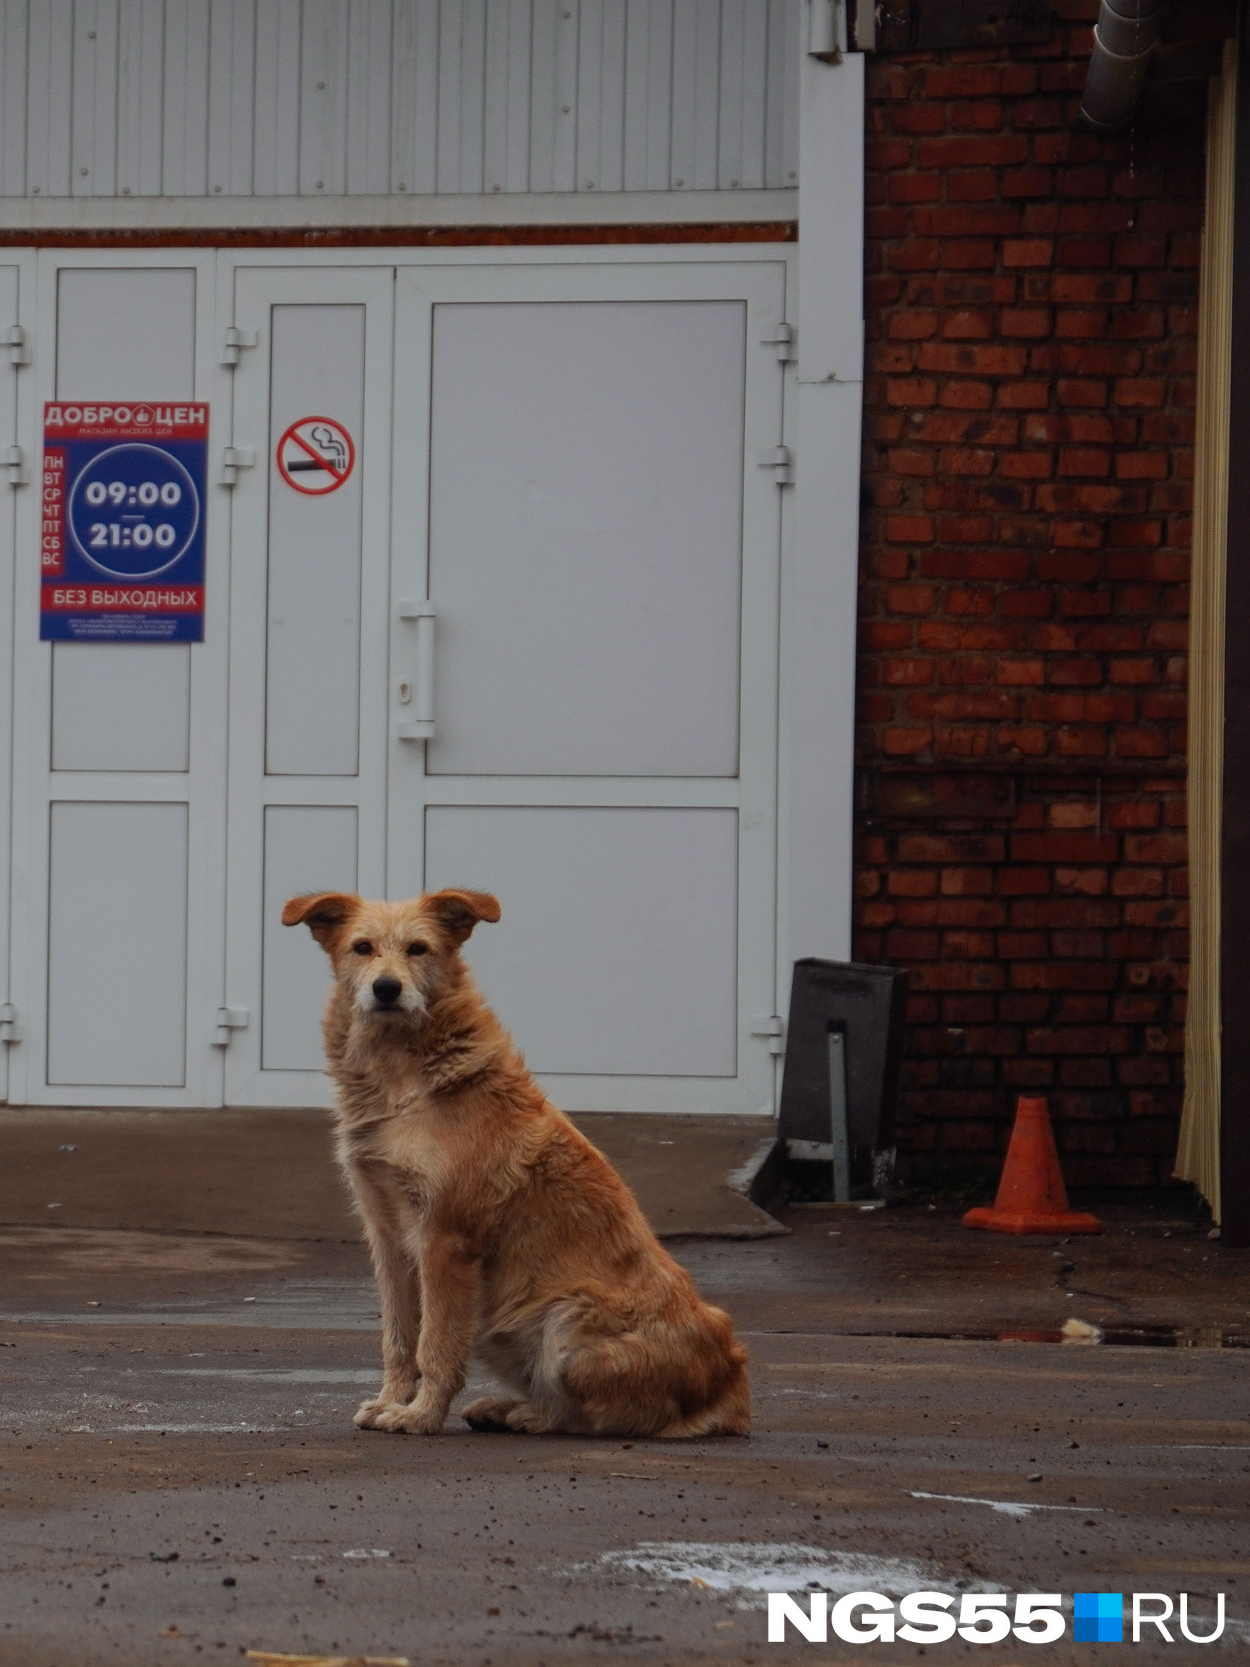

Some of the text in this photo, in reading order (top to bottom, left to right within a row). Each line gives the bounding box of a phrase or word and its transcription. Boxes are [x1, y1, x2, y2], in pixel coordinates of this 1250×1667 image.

[155, 427, 173, 435] ЦЕН
[44, 456, 64, 468] ПН
[44, 472, 61, 484] ВТ
[43, 488, 61, 500] СР
[86, 481, 182, 505] 09:00
[43, 504, 61, 516] ЧТ
[43, 520, 60, 532] ПТ
[90, 523, 176, 546] 21:00
[42, 536, 60, 548] СБ
[42, 552, 60, 565] ВС
[54, 590, 197, 608] БЕЗ ВЫХОДНЫХ
